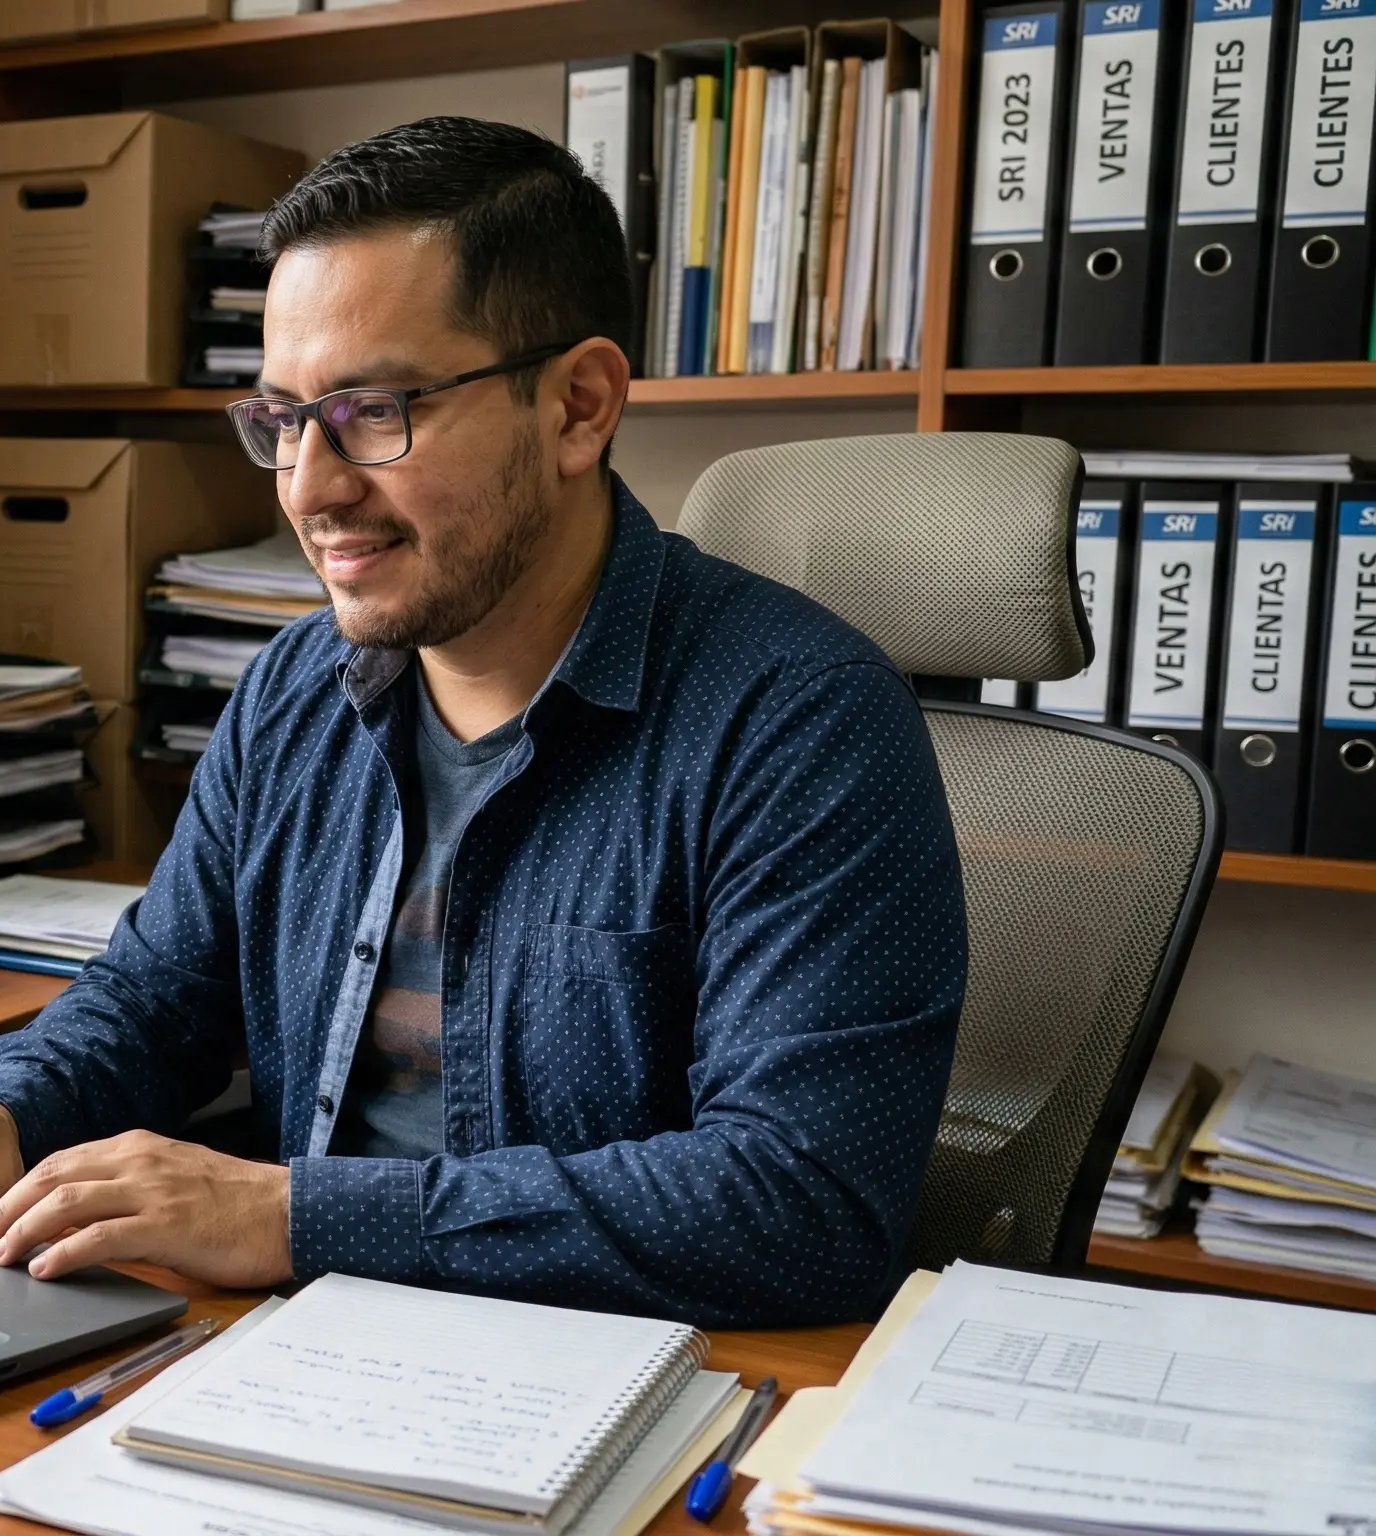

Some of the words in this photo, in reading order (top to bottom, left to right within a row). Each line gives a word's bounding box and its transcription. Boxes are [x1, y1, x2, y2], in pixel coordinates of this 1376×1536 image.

[1002, 72, 1032, 146] 2023
[1098, 59, 1133, 183] VENTAS
[1207, 39, 1245, 187] CLIENTES
[1313, 36, 1354, 187] CLIENTES
[999, 156, 1027, 202] SRI
[1154, 561, 1192, 694] VENTAS
[1252, 561, 1287, 694] CLIENTAS
